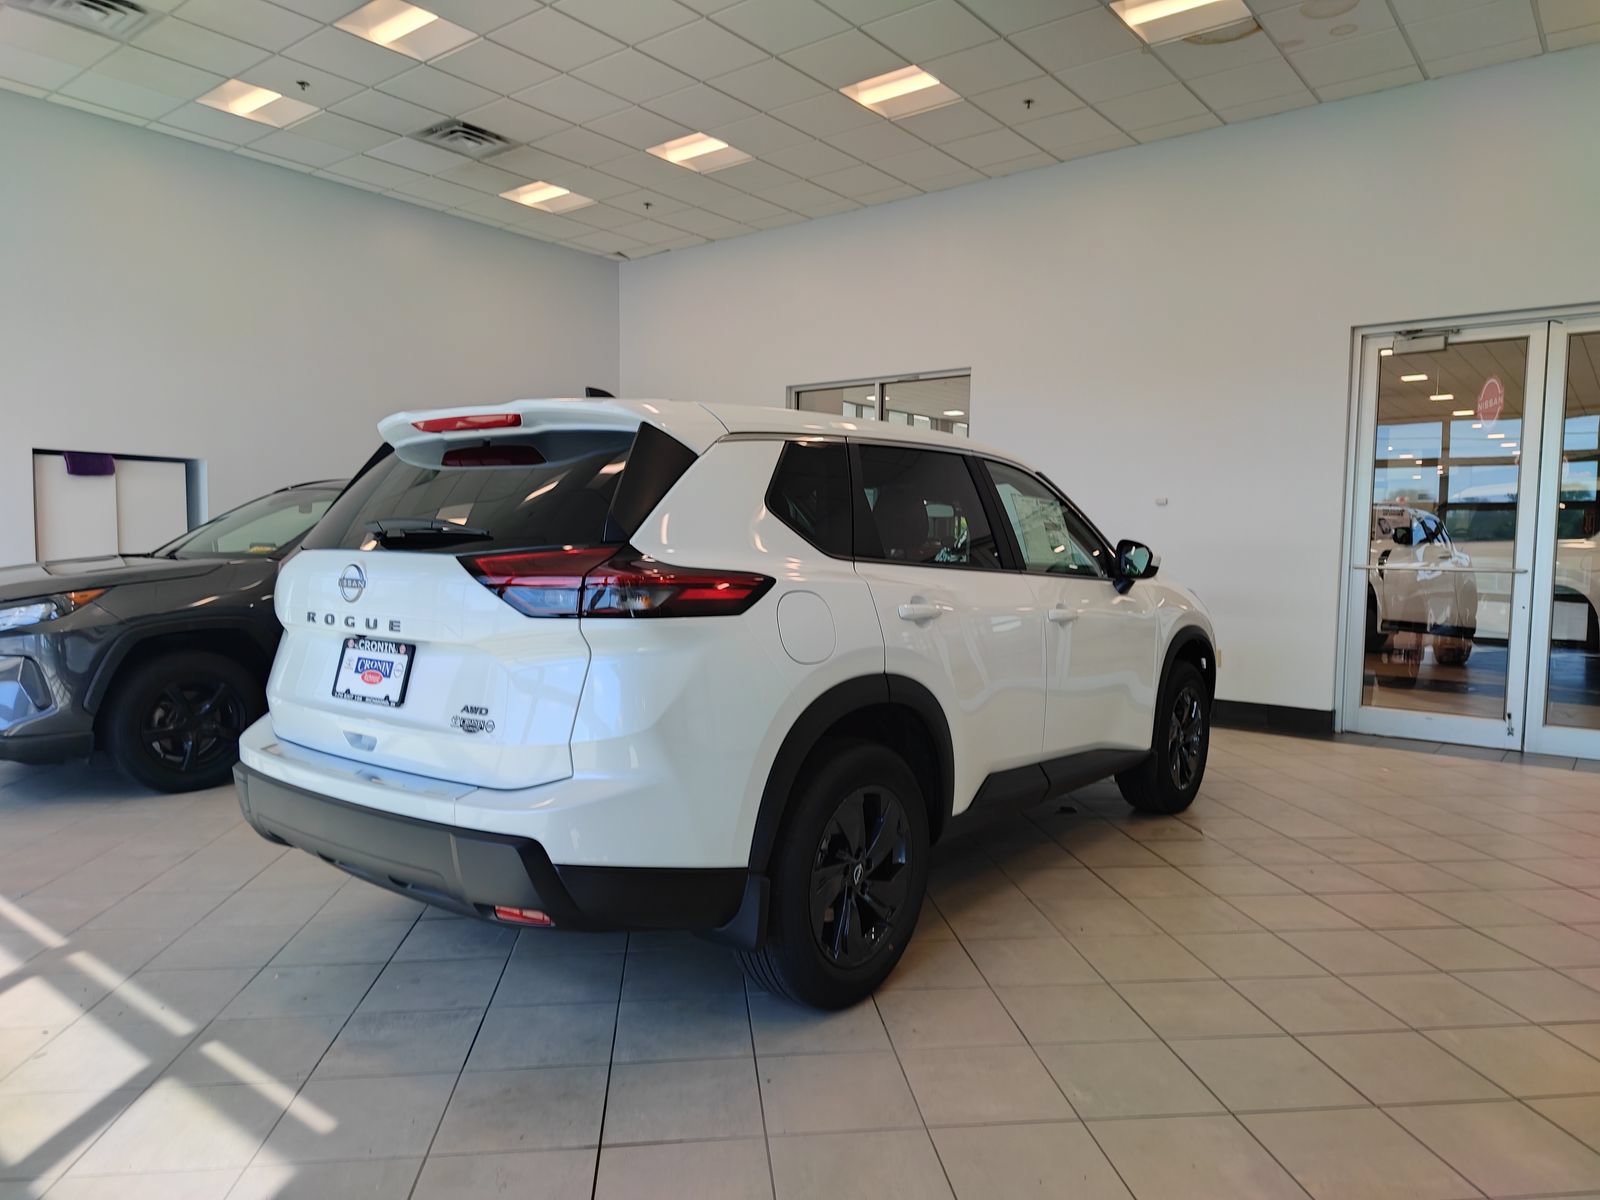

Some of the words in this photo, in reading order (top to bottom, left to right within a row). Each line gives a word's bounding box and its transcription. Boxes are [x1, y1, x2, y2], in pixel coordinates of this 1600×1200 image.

[1478, 395, 1504, 410] NISSAN
[340, 578, 366, 588] SSAN
[306, 611, 401, 632] ROGUE
[358, 640, 396, 654] CRONIN
[358, 660, 393, 677] CRONIN
[461, 705, 489, 716] AWD
